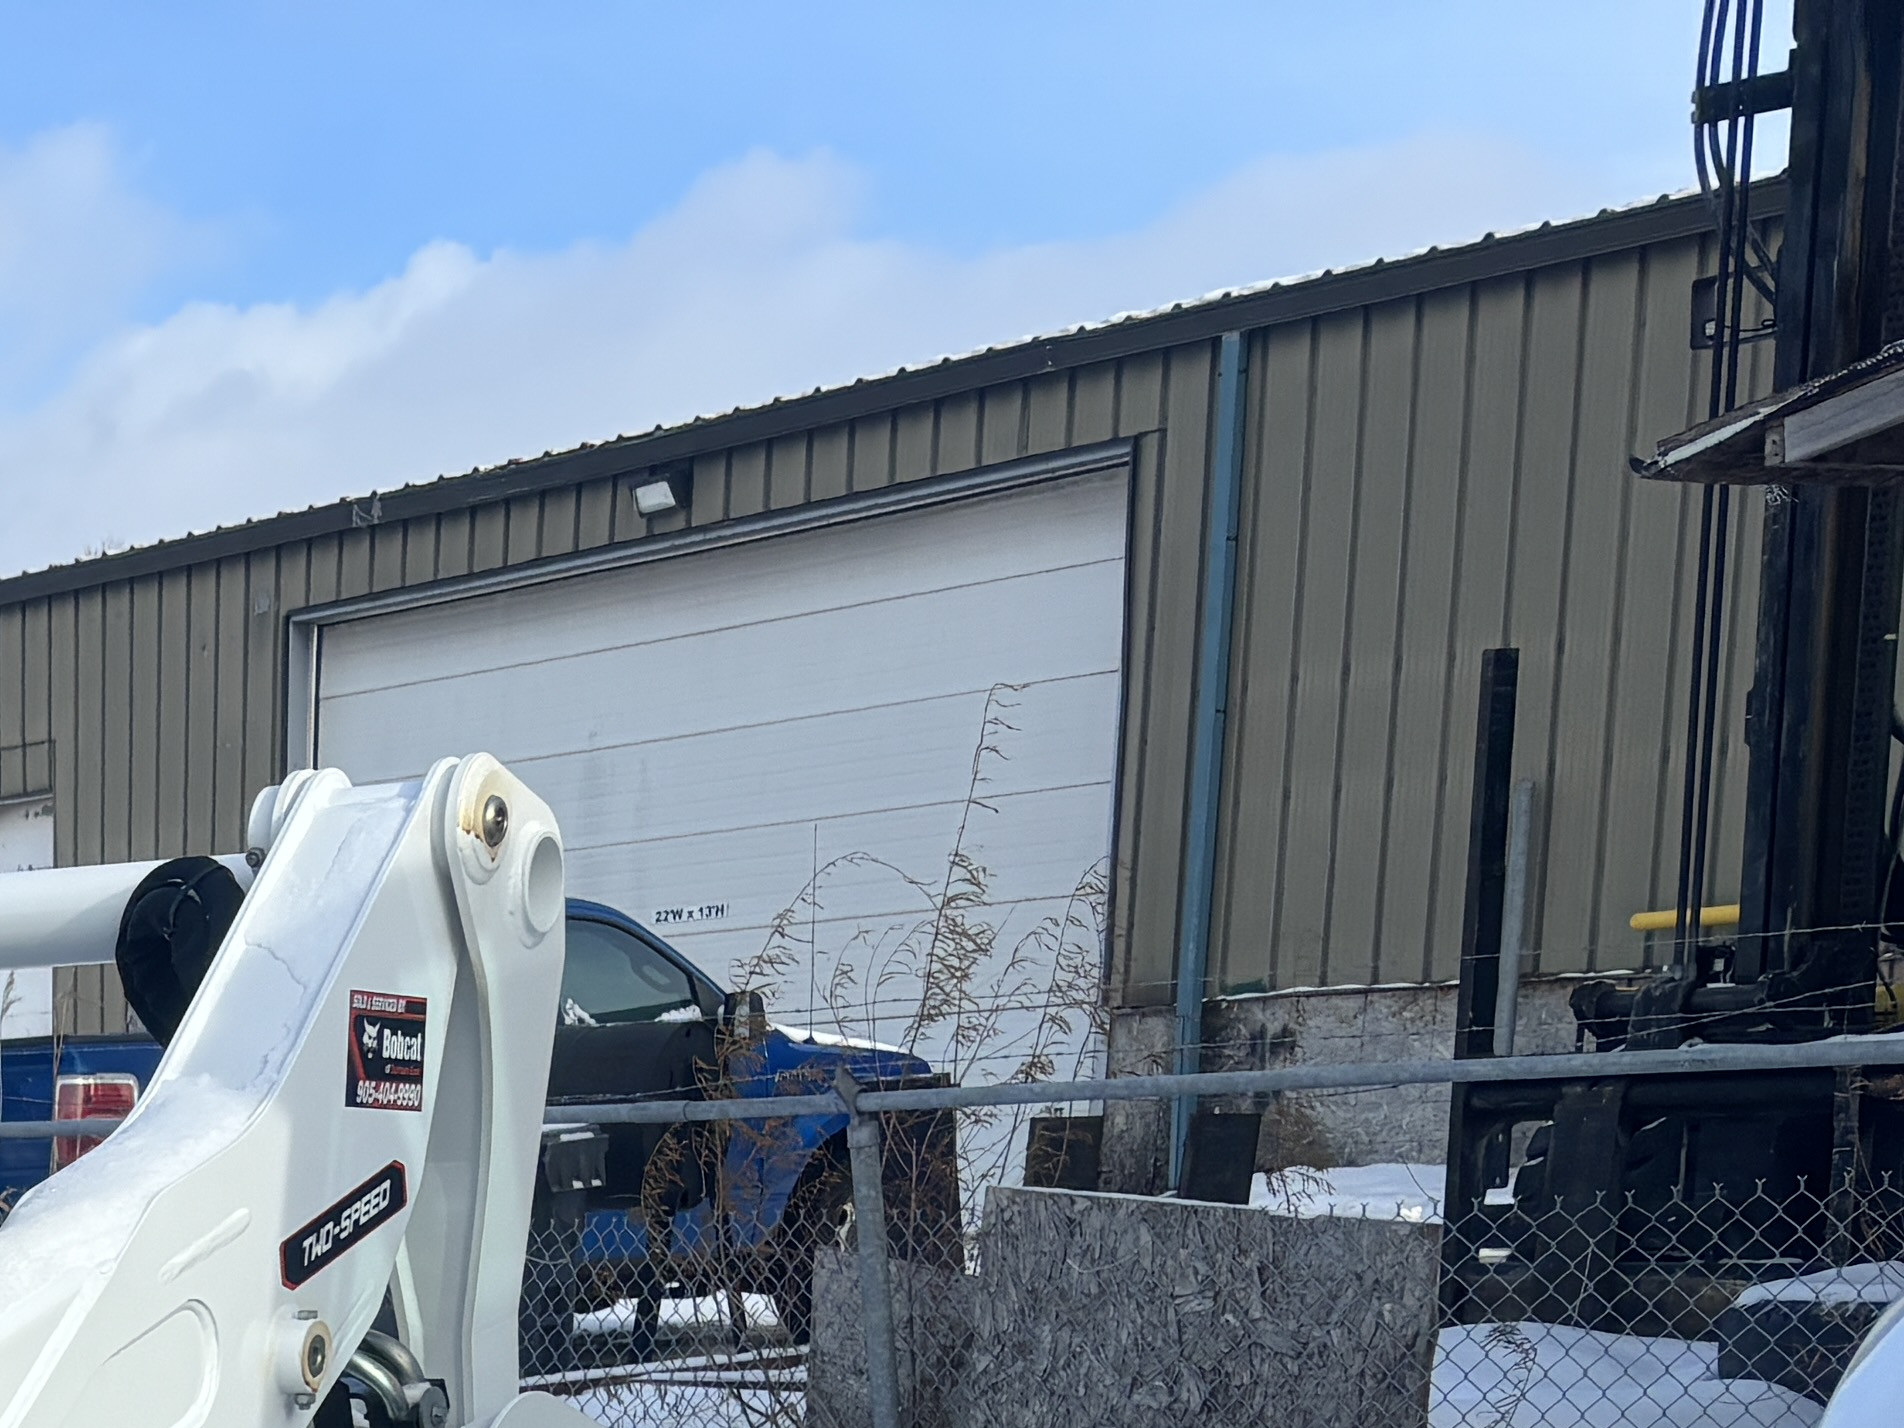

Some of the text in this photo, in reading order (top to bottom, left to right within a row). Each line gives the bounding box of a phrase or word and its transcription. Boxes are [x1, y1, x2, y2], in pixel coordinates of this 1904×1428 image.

[382, 1028, 421, 1062] Bobcat
[356, 1080, 421, 1107] 905-404-9990
[302, 1179, 391, 1266] TWO-SPEED
